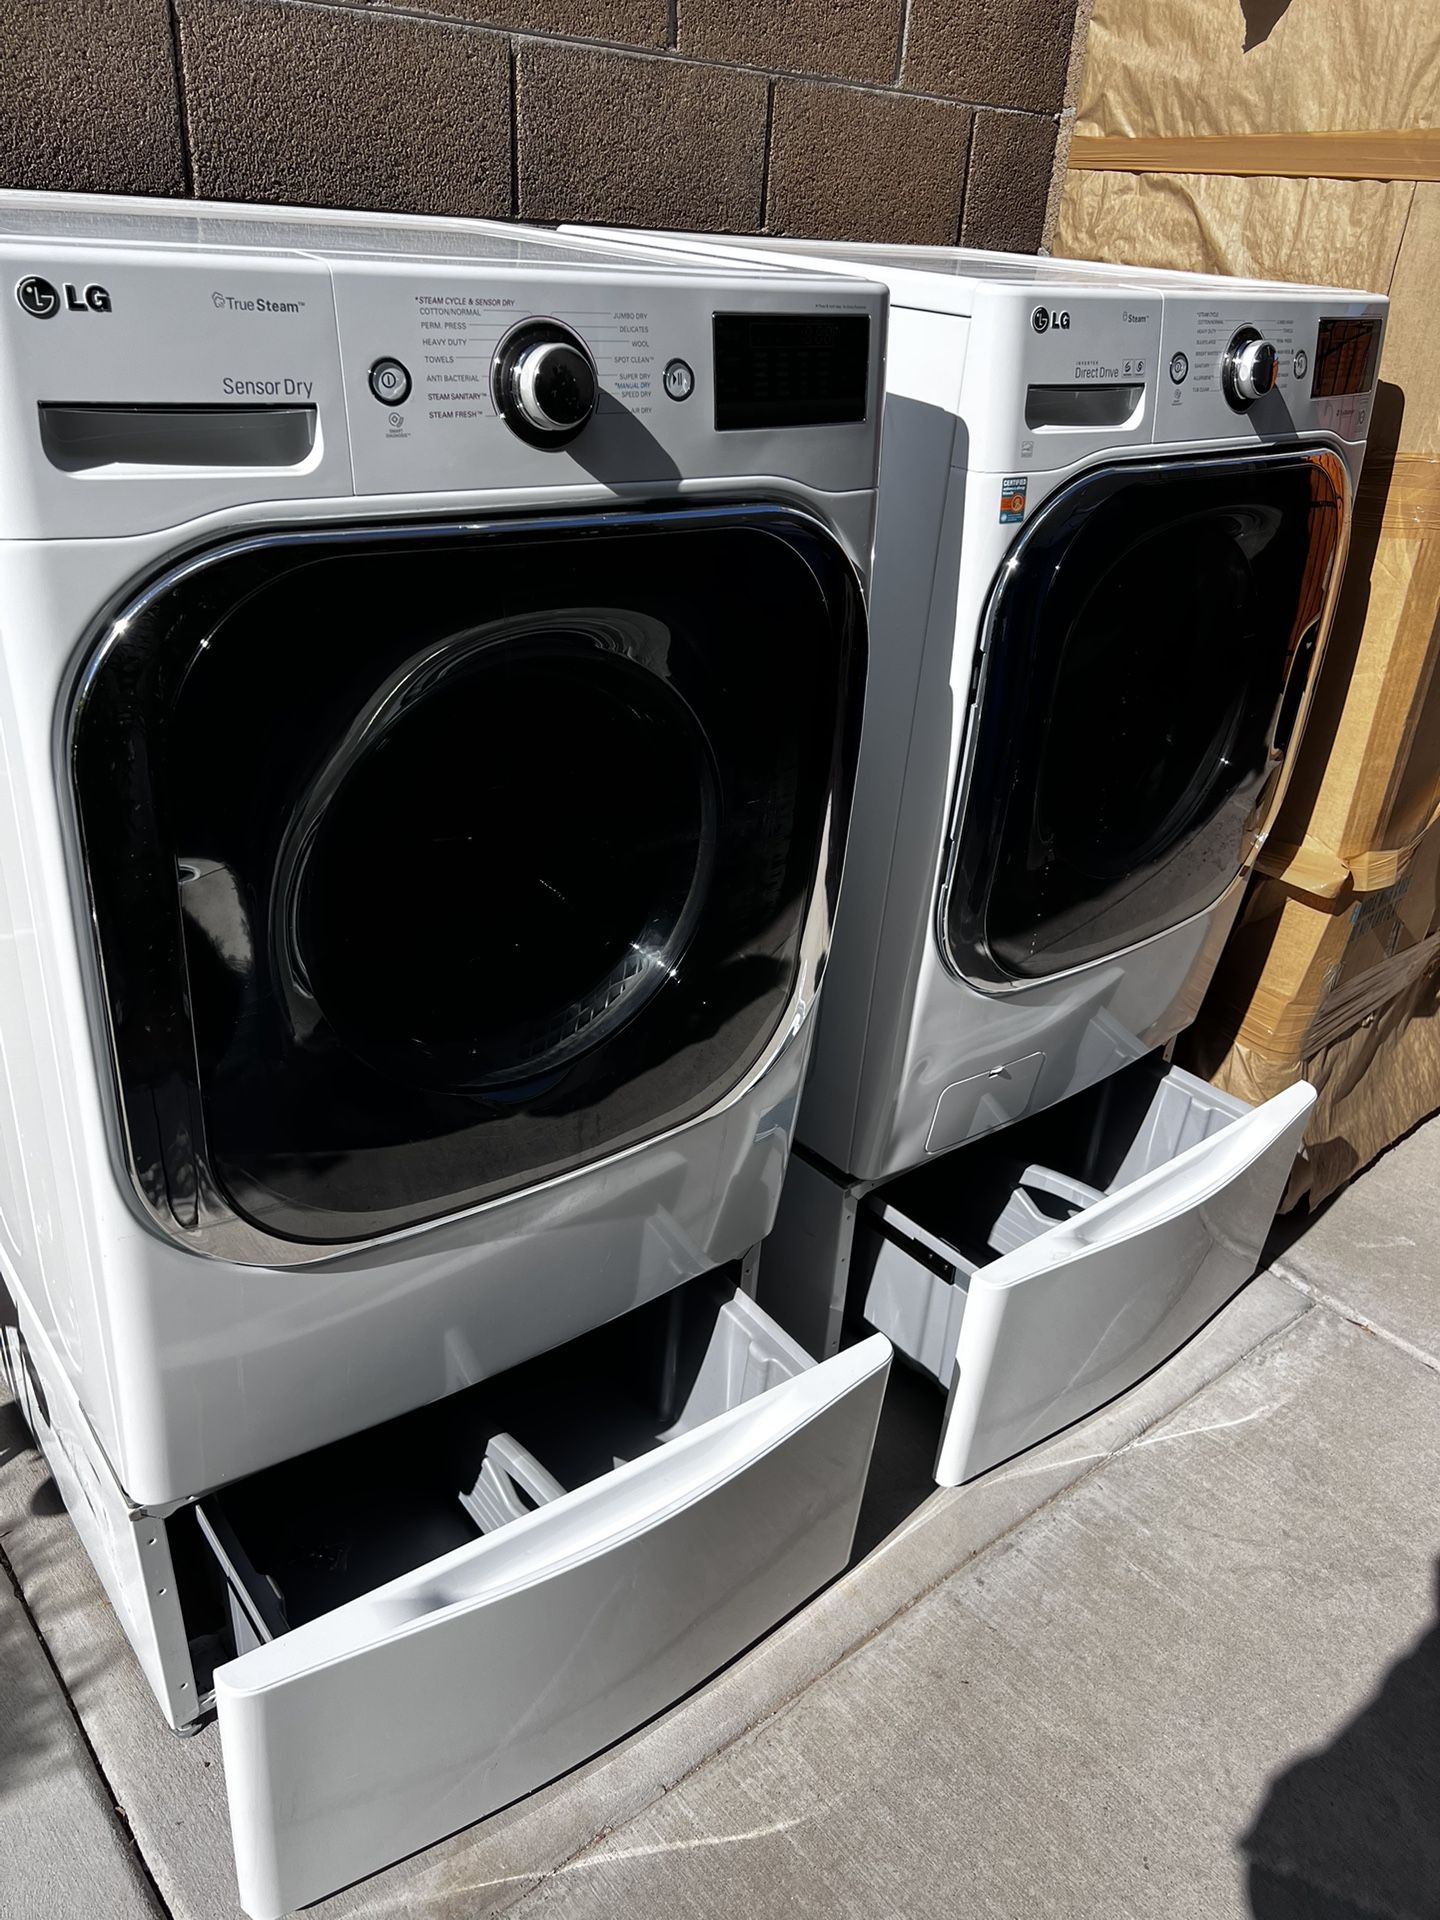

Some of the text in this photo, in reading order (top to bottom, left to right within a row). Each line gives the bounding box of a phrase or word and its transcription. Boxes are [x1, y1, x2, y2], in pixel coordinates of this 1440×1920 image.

[63, 284, 112, 313] LG
[445, 297, 466, 305] CYCLE
[468, 297, 474, 305] &
[475, 298, 501, 306] SENSOR
[502, 299, 515, 307] DRY
[226, 296, 255, 311] True
[419, 307, 481, 316] COTTON/NORMAL
[1051, 311, 1071, 330] LG
[445, 322, 467, 330] PRESS
[422, 338, 467, 346] HEAVY DUTY
[632, 340, 650, 348] WOOL
[1075, 366, 1119, 379] Direct Drive
[426, 374, 442, 382] ANTI
[223, 378, 313, 399] Sensor Dry
[640, 382, 651, 390] DRY
[428, 393, 450, 401] STEAM
[429, 411, 453, 419] STEAM
